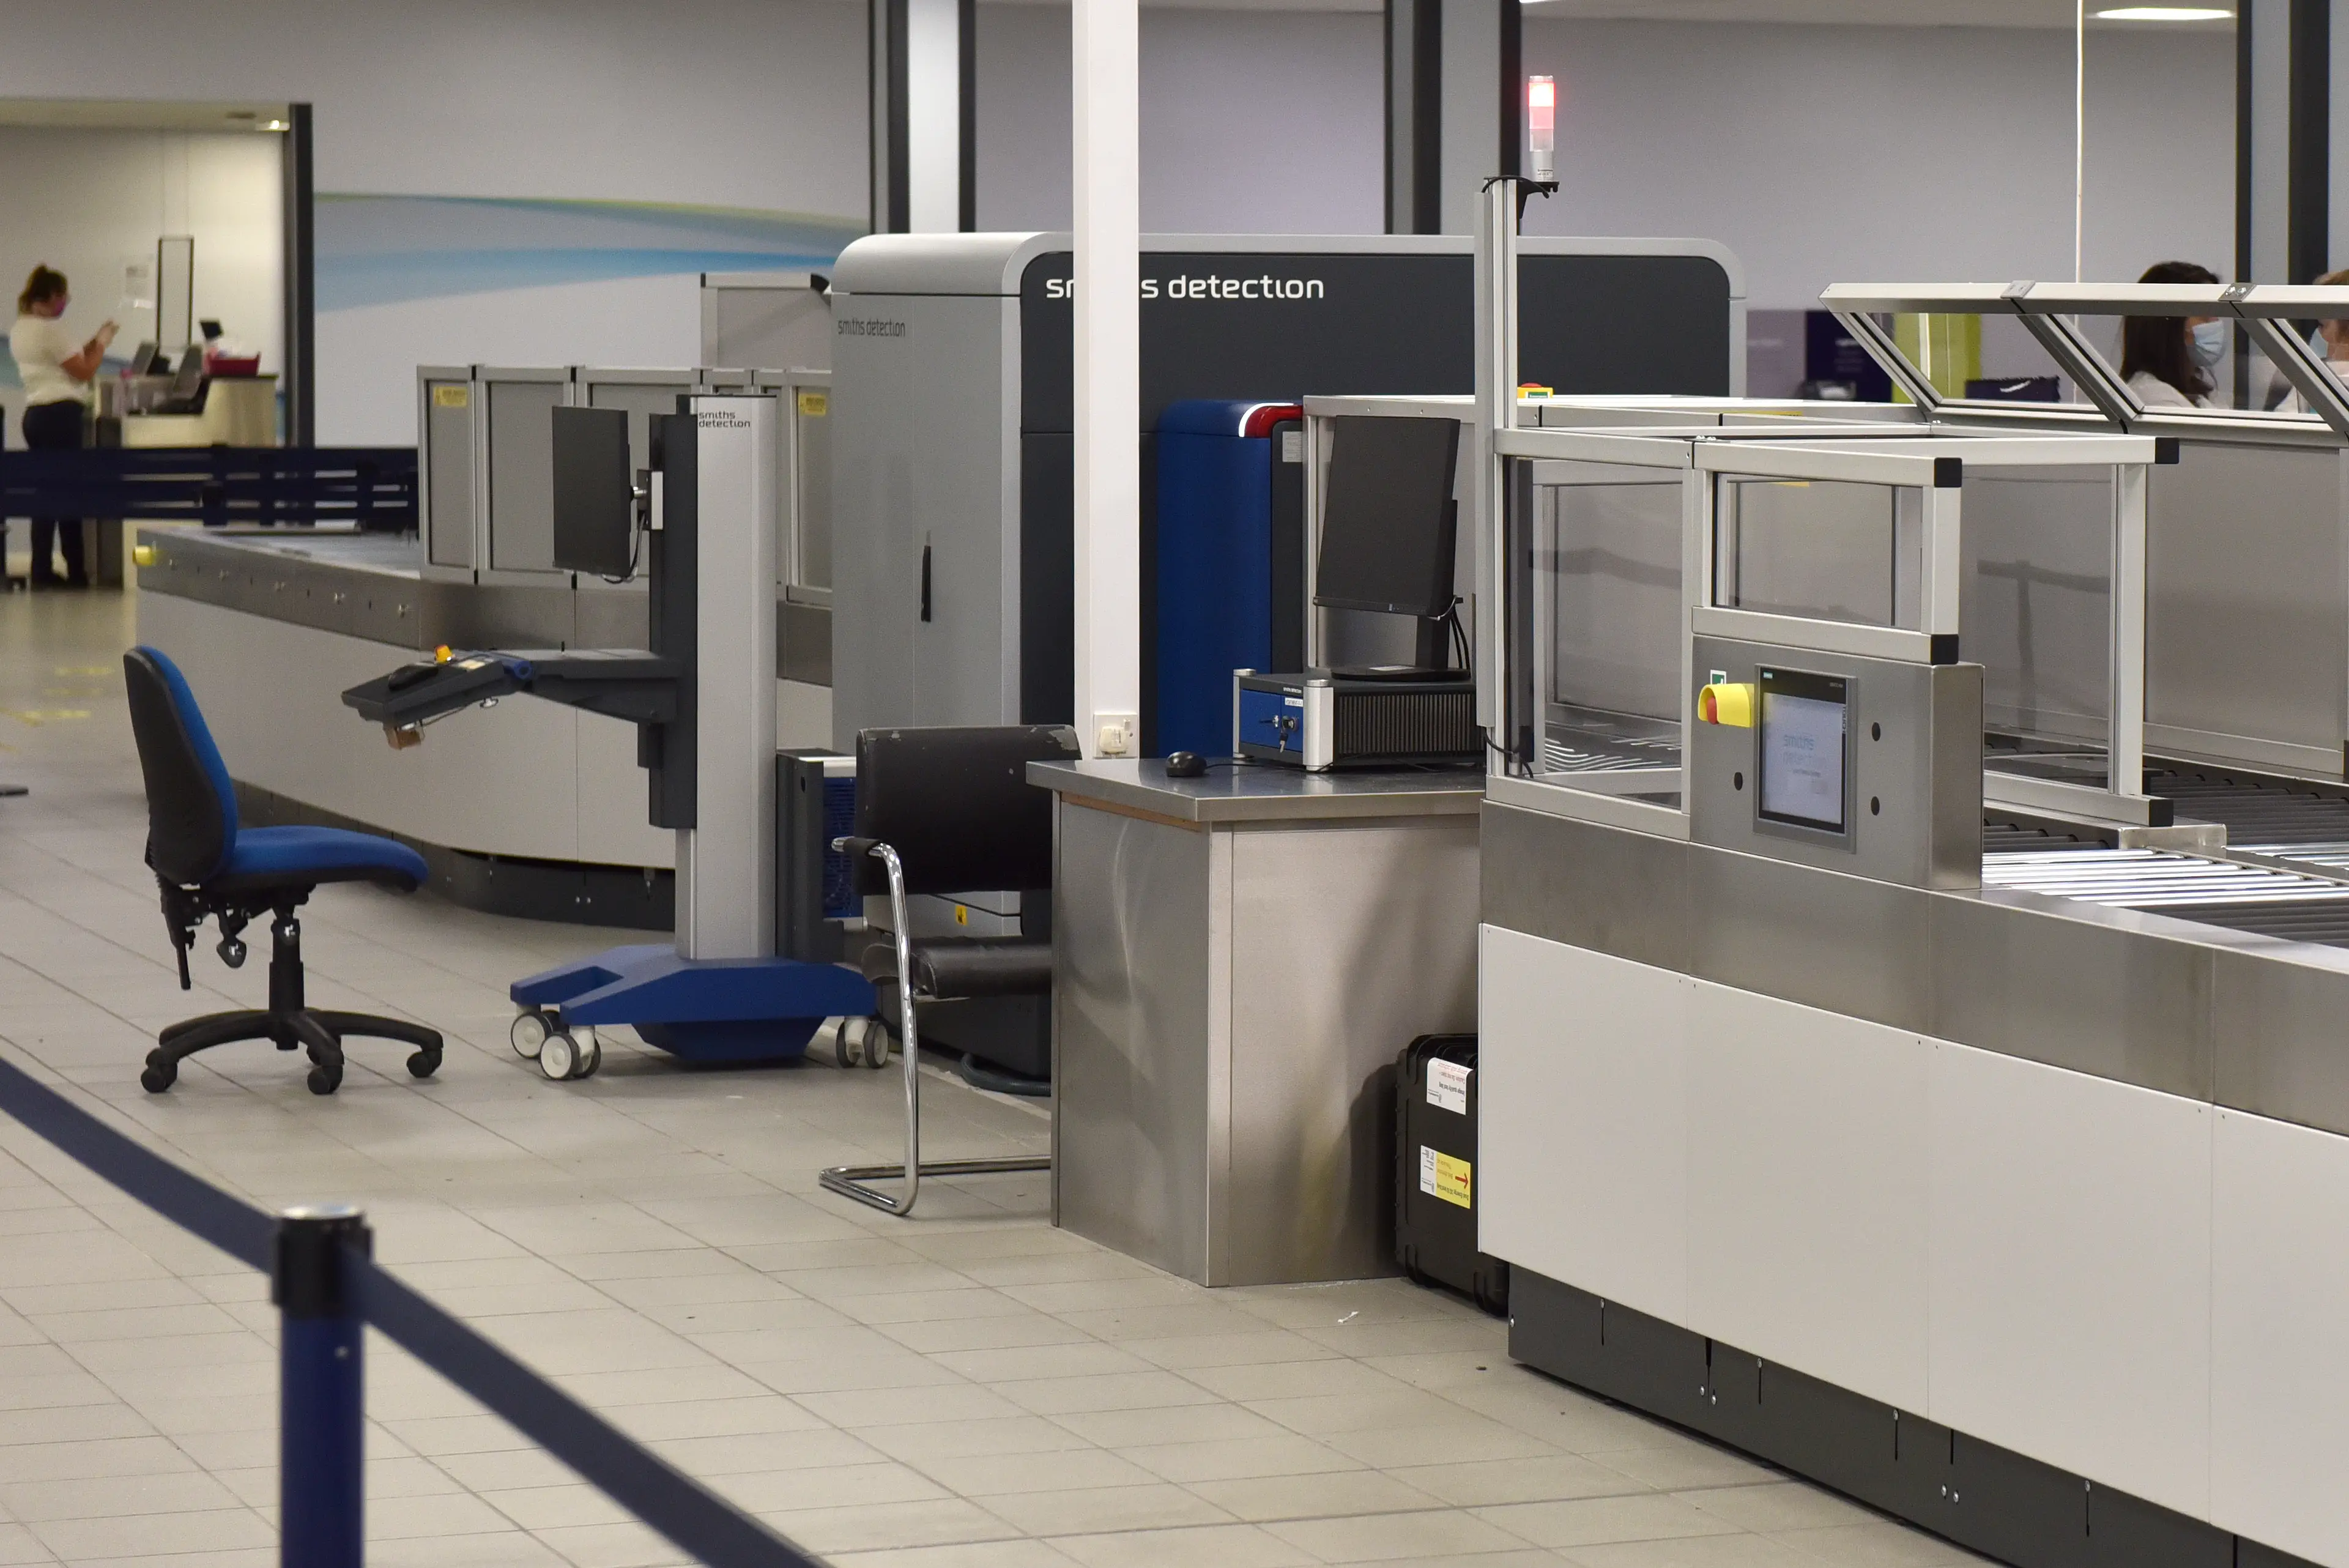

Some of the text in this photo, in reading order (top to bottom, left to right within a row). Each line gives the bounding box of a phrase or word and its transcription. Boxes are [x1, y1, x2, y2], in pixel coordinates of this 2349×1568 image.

[1168, 275, 1324, 299] detection
[837, 318, 906, 338] smiths detection
[699, 411, 736, 420] smiths
[699, 419, 751, 428] detection
